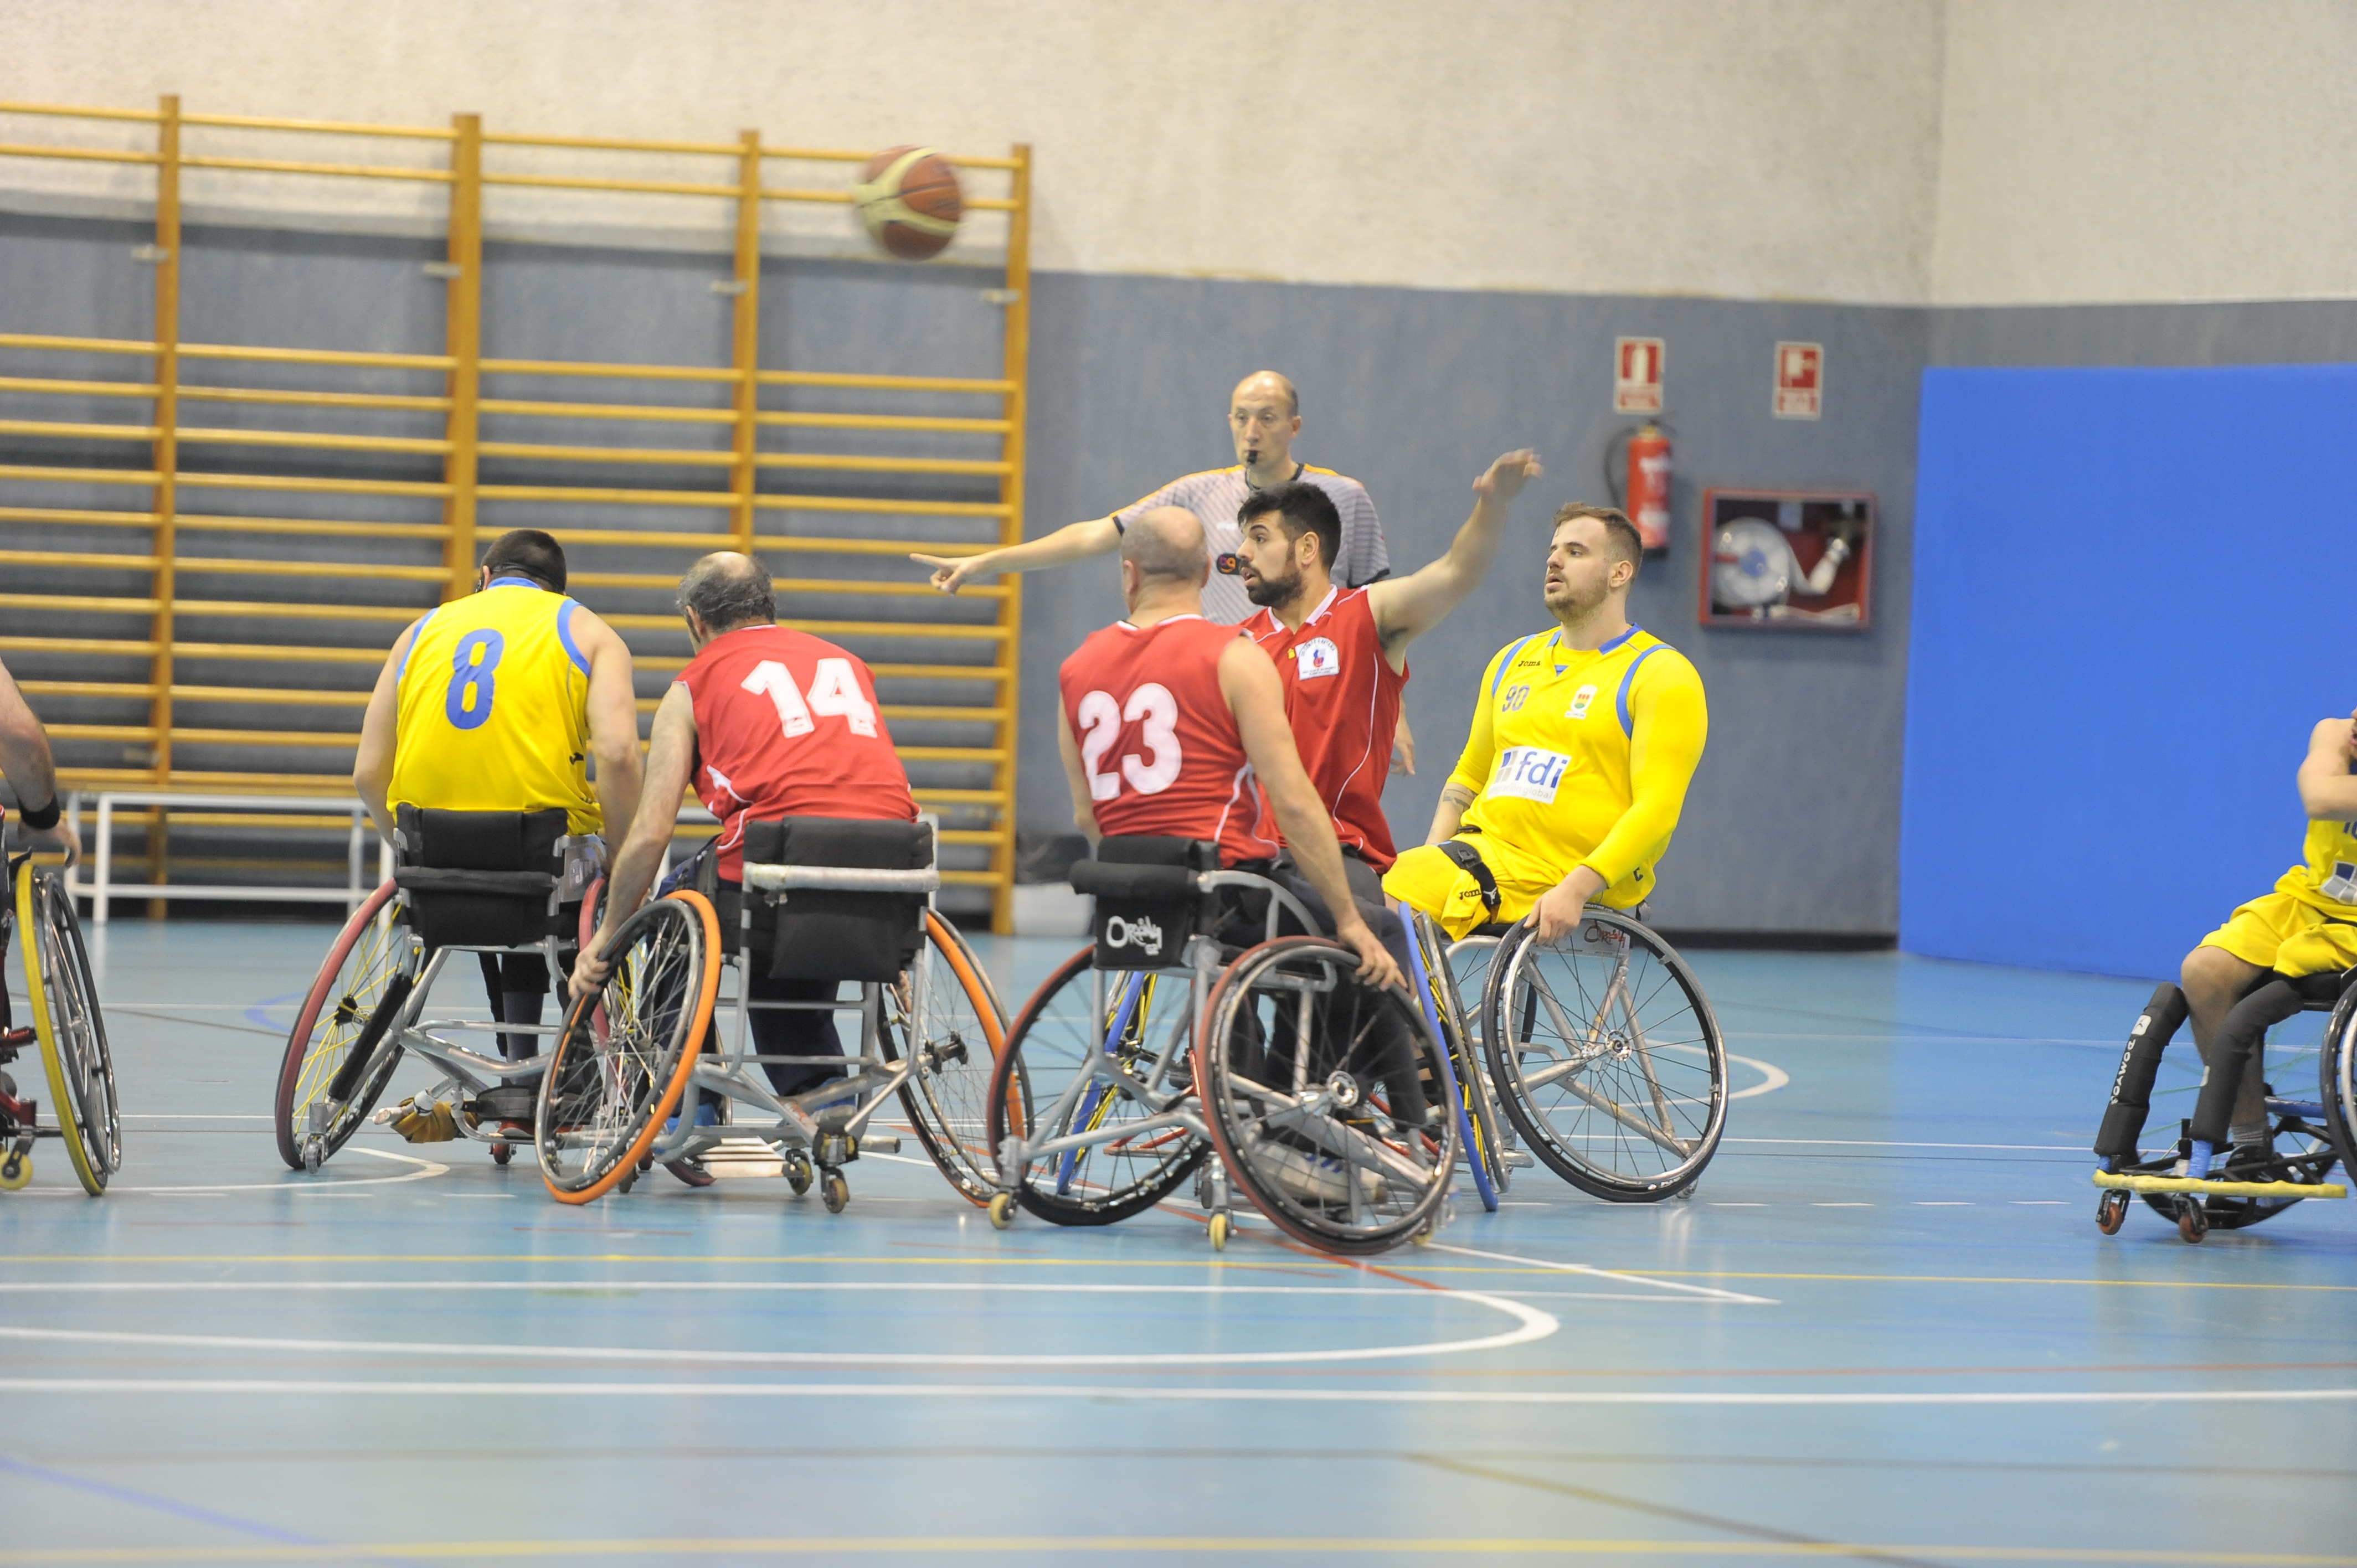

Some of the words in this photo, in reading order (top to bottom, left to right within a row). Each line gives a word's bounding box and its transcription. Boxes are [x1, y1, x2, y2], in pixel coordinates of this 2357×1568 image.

[446, 628, 505, 730] 8
[741, 657, 878, 739] 14
[1502, 685, 1530, 712] 90
[1078, 682, 1182, 801] 23
[1515, 751, 1568, 788] fdi
[1522, 786, 1553, 799] global
[1459, 889, 1482, 900] Jom
